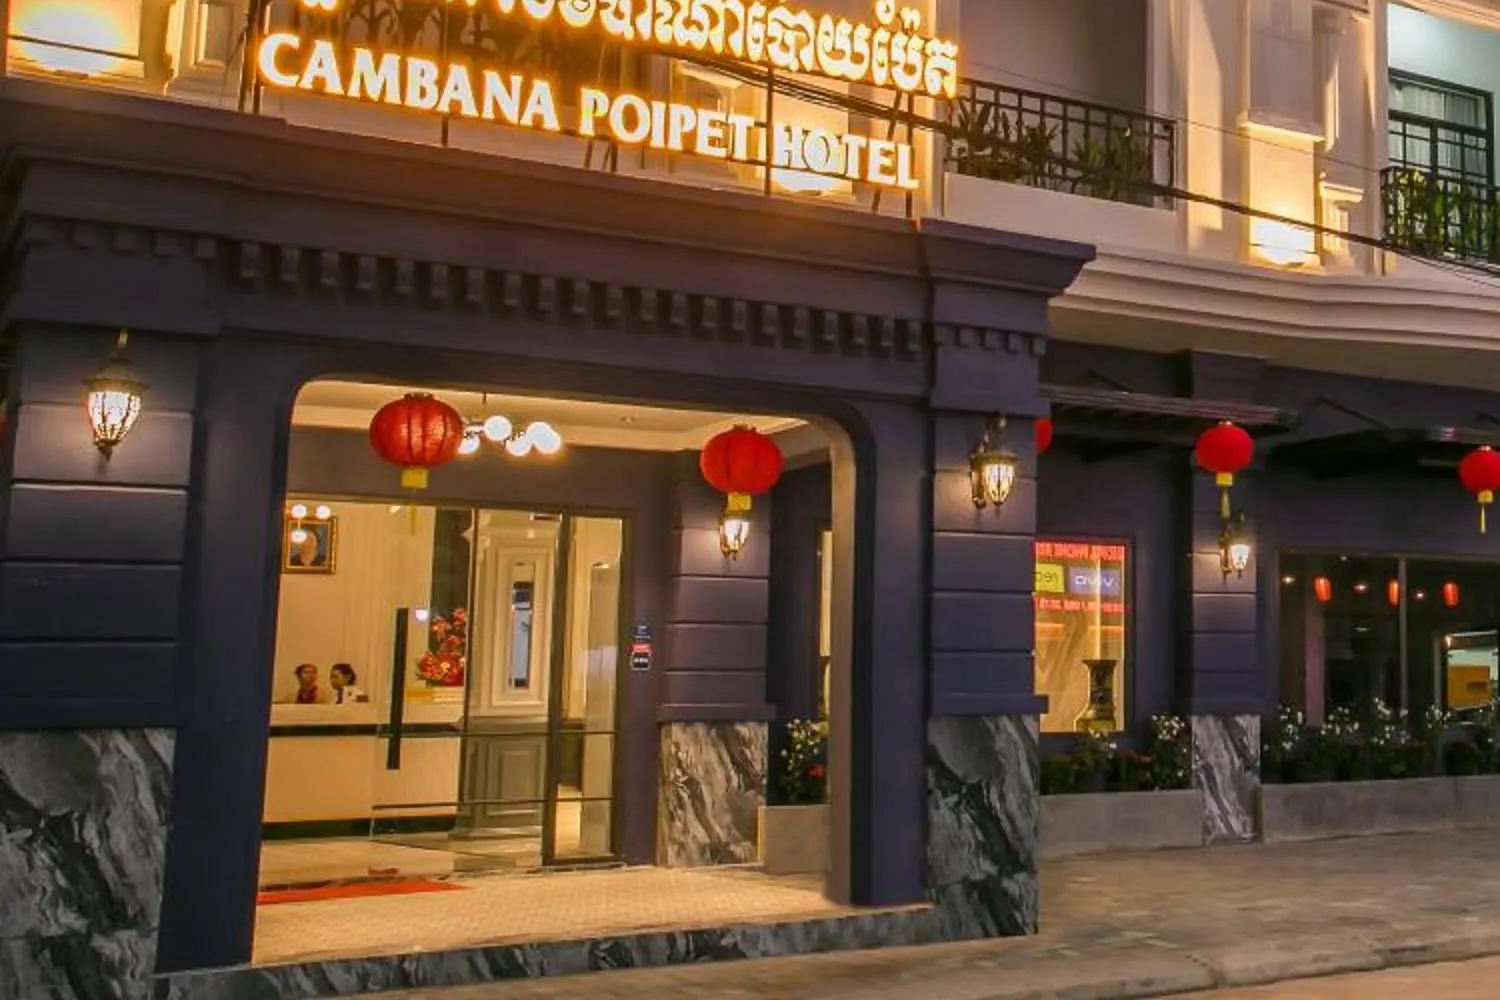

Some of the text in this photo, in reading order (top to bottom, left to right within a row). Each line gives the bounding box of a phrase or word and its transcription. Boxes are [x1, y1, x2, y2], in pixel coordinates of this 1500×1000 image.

[257, 32, 920, 190] CAMBANA POIPET HOTEL
